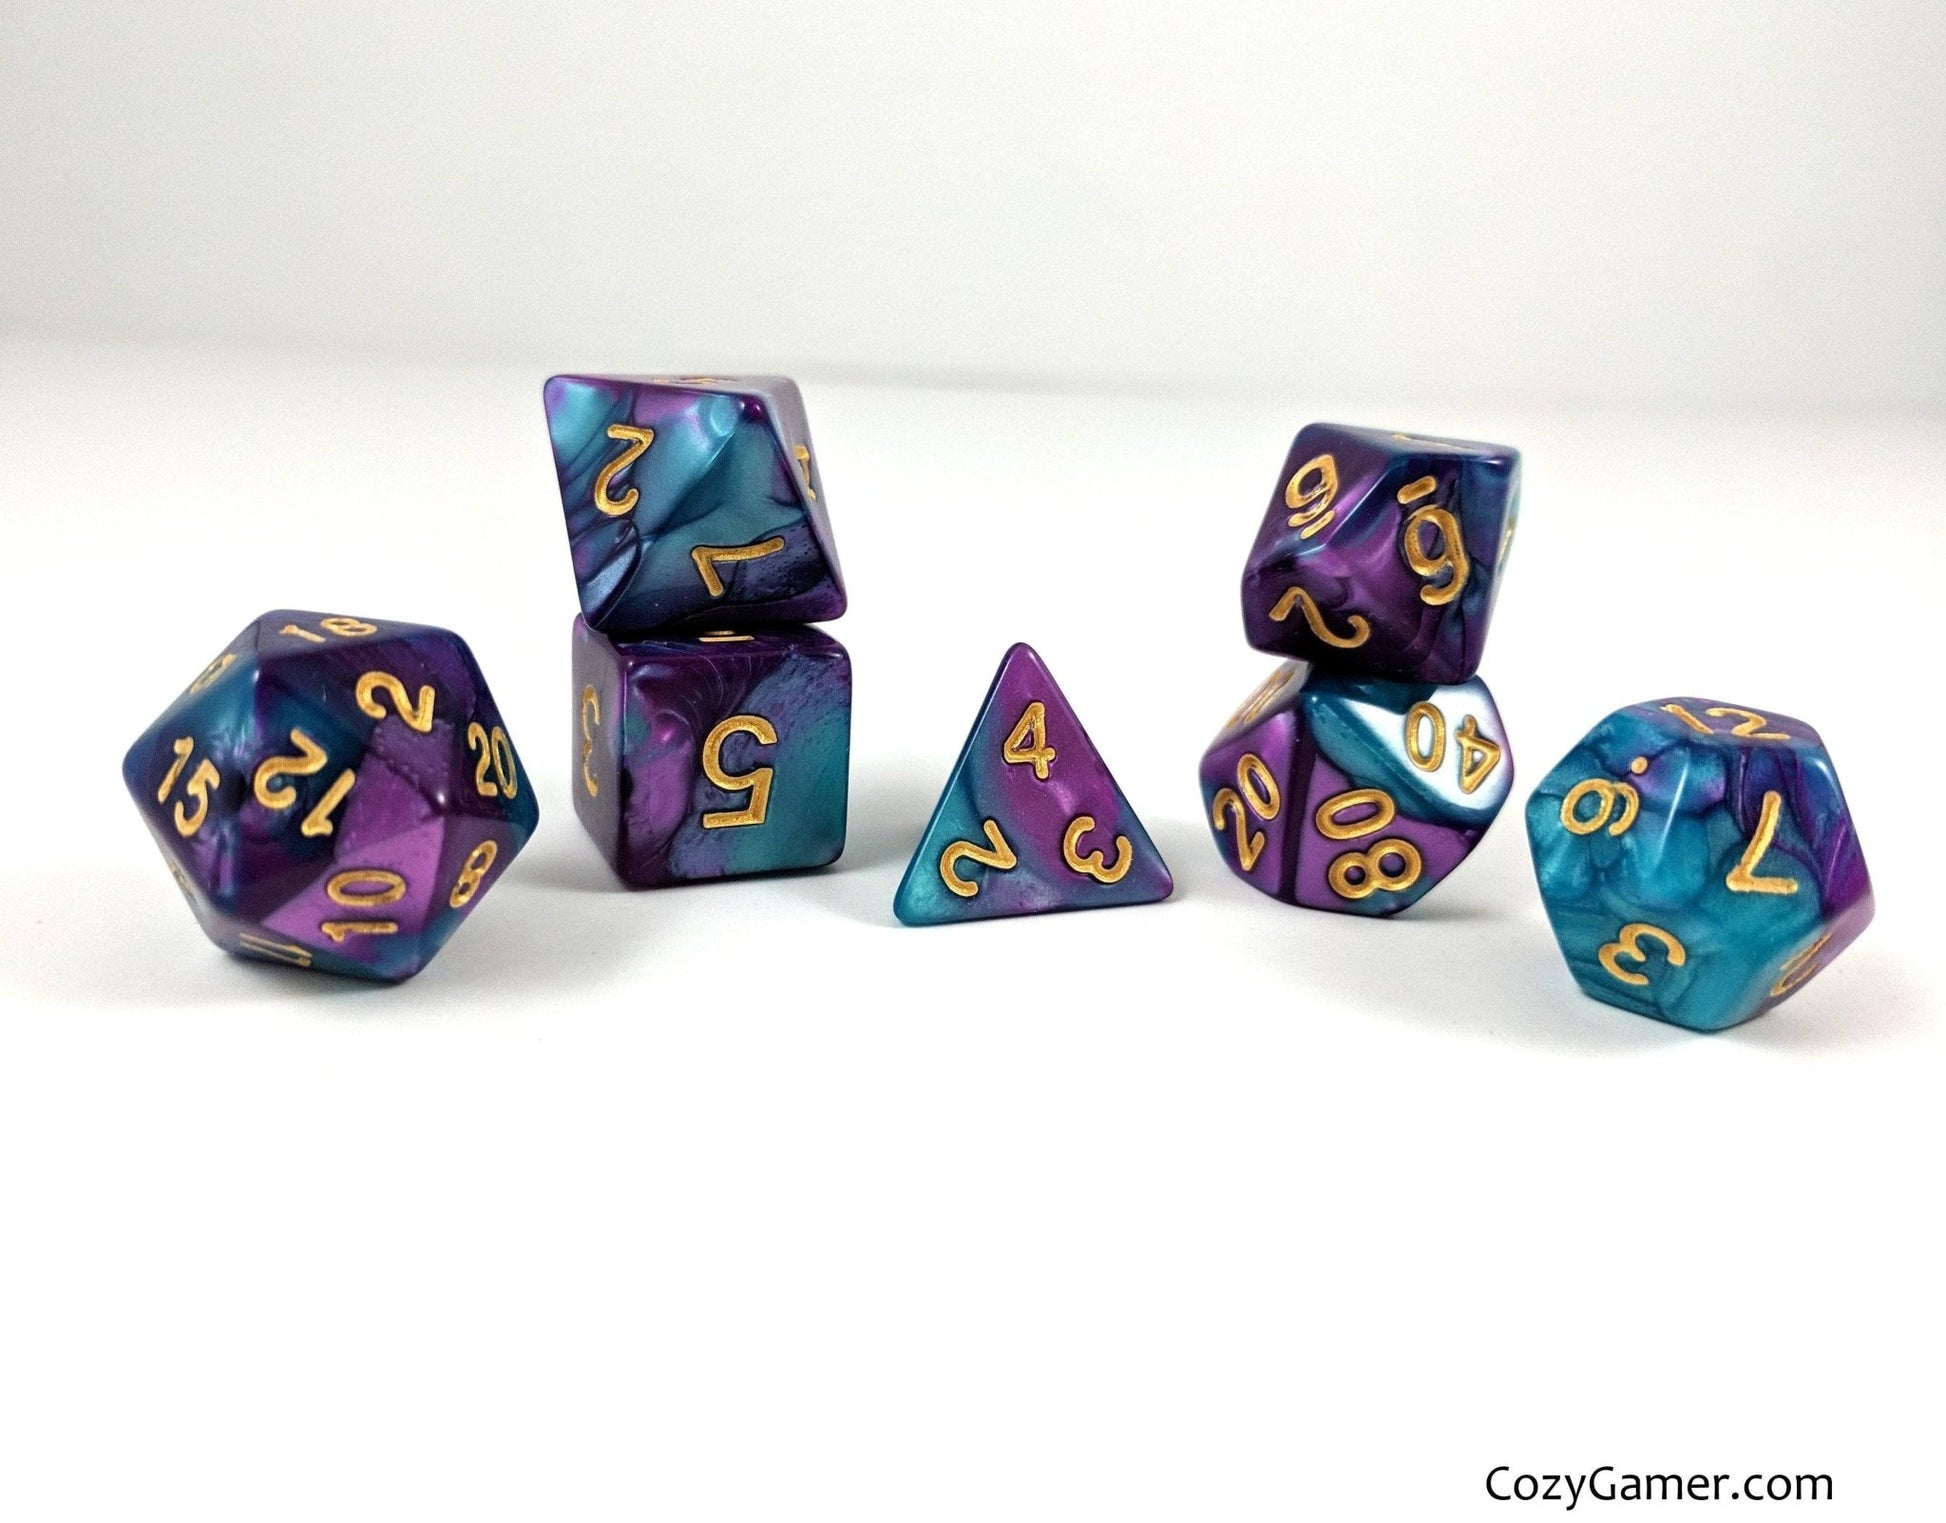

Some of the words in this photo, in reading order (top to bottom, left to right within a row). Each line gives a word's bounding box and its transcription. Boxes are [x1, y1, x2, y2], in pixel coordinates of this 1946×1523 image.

[595, 424, 655, 517] 2
[355, 671, 436, 733] 2
[1003, 701, 1056, 780] 4
[1661, 704, 1791, 740] 12
[158, 736, 221, 838] 15
[467, 721, 519, 799] 20
[702, 714, 778, 829] 5
[1404, 701, 1501, 795] 40
[1062, 815, 1133, 884] 3
[1212, 753, 1281, 872] 20
[1315, 788, 1422, 900] 80
[1726, 790, 1799, 895] 7
[450, 840, 498, 909] 8
[939, 819, 1017, 898] 2
[321, 869, 407, 943] 10
[1598, 922, 1687, 986] 3
